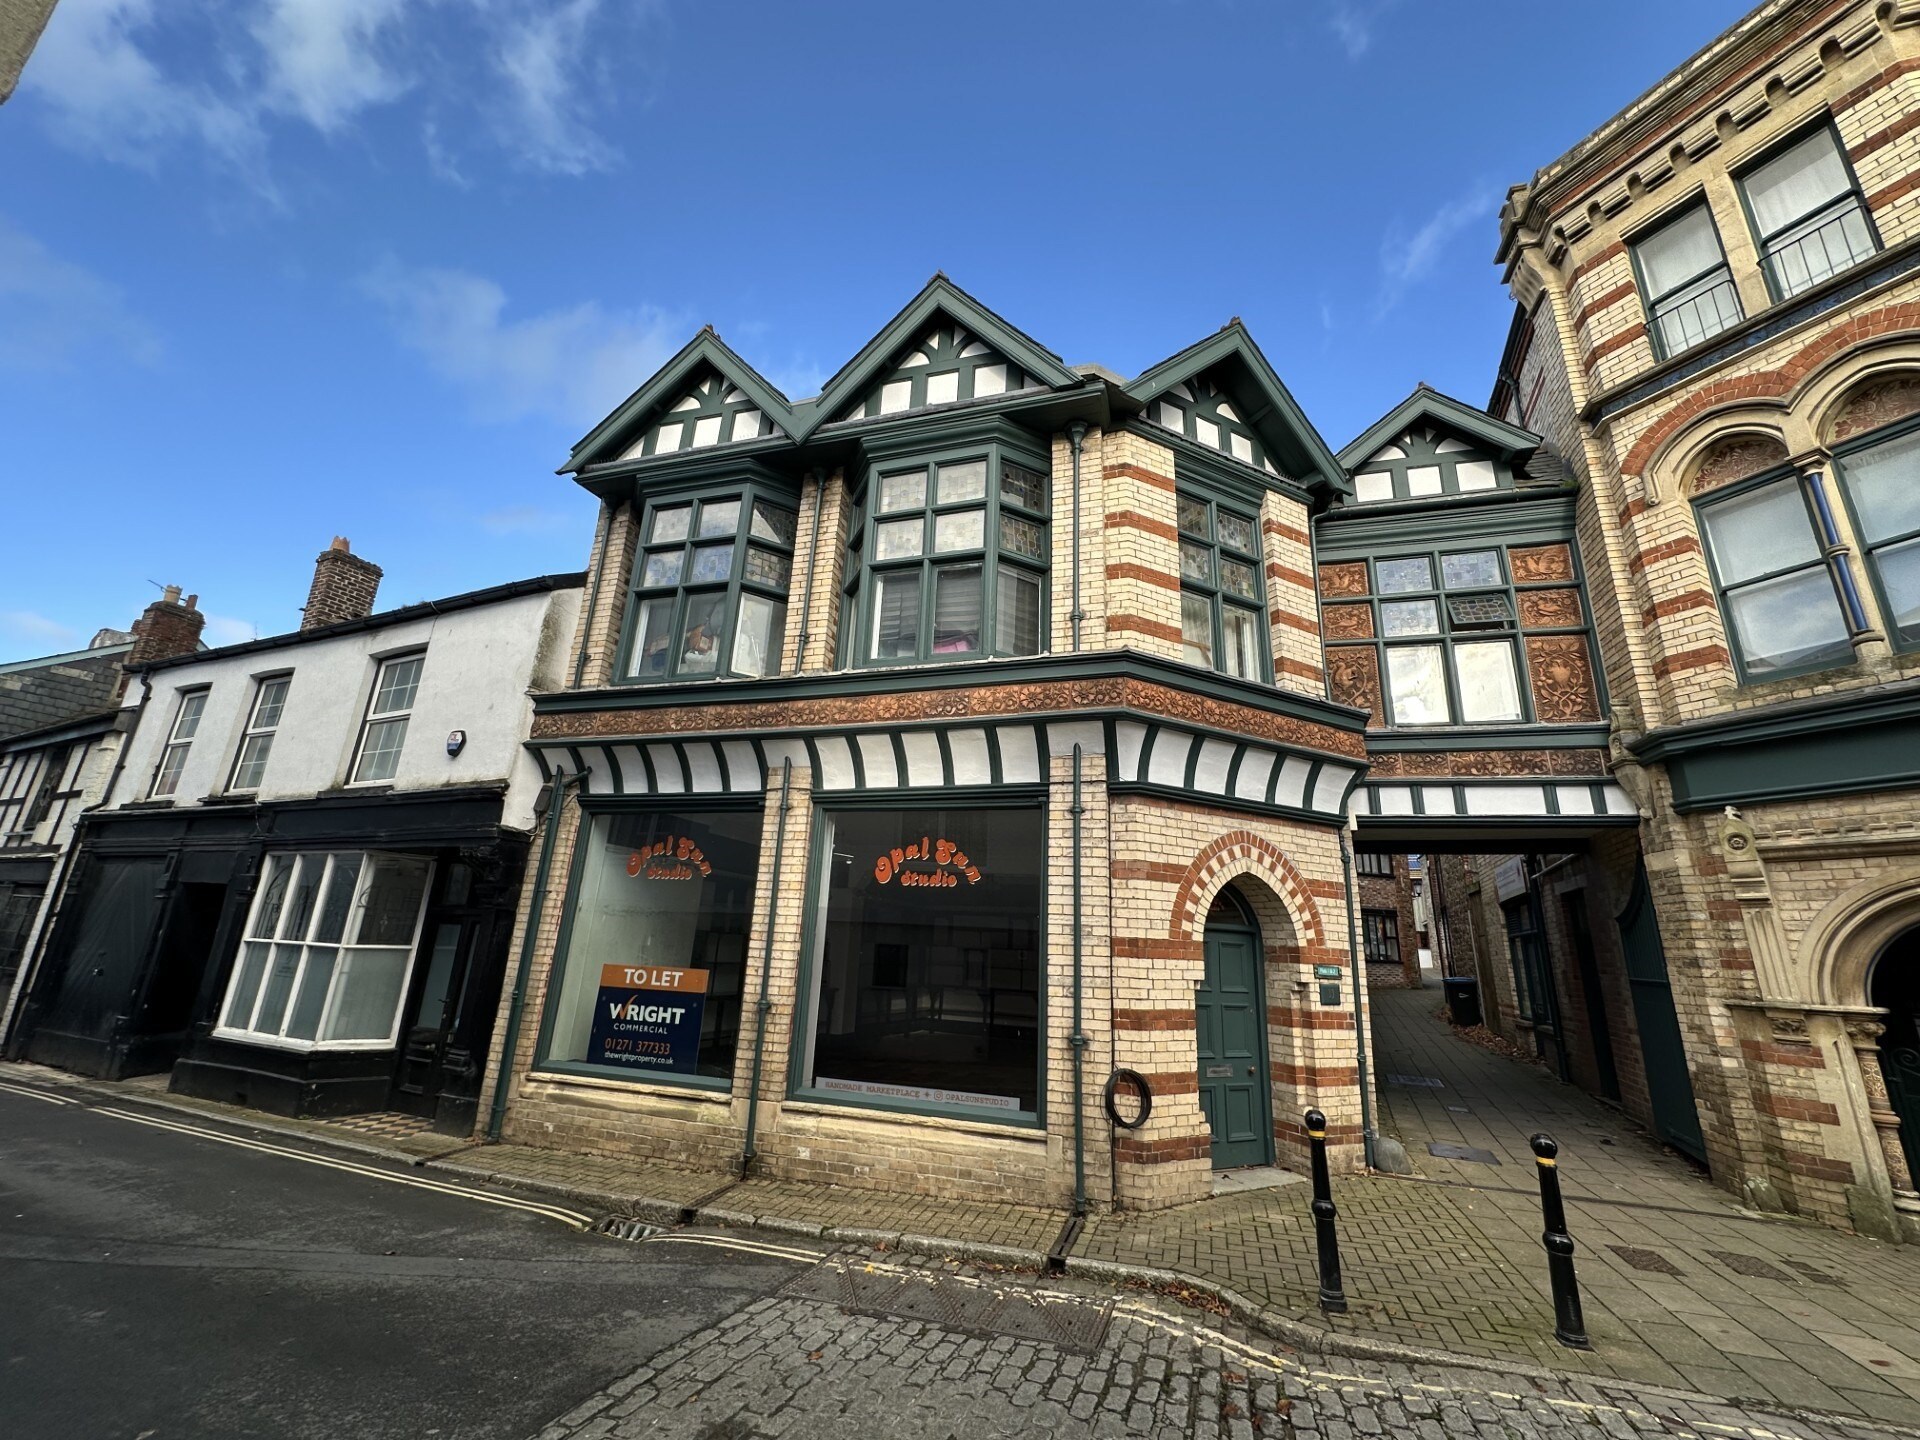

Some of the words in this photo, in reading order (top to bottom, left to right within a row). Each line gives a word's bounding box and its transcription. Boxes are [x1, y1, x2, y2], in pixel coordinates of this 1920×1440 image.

[875, 836, 930, 884] Opal
[624, 968, 647, 985] TO
[651, 970, 684, 987] LET
[609, 995, 685, 1025] WRIGHT
[613, 1022, 668, 1035] COMMERCIAL
[604, 1037, 633, 1051] 01271
[635, 1040, 671, 1055] 377333
[604, 1050, 674, 1065] thewrightproperty.co.uk
[825, 1081, 863, 1092] HANDMADE
[866, 1085, 921, 1098] MARKETPLACE
[945, 1093, 1010, 1107] OPALSUNSTUDIO
